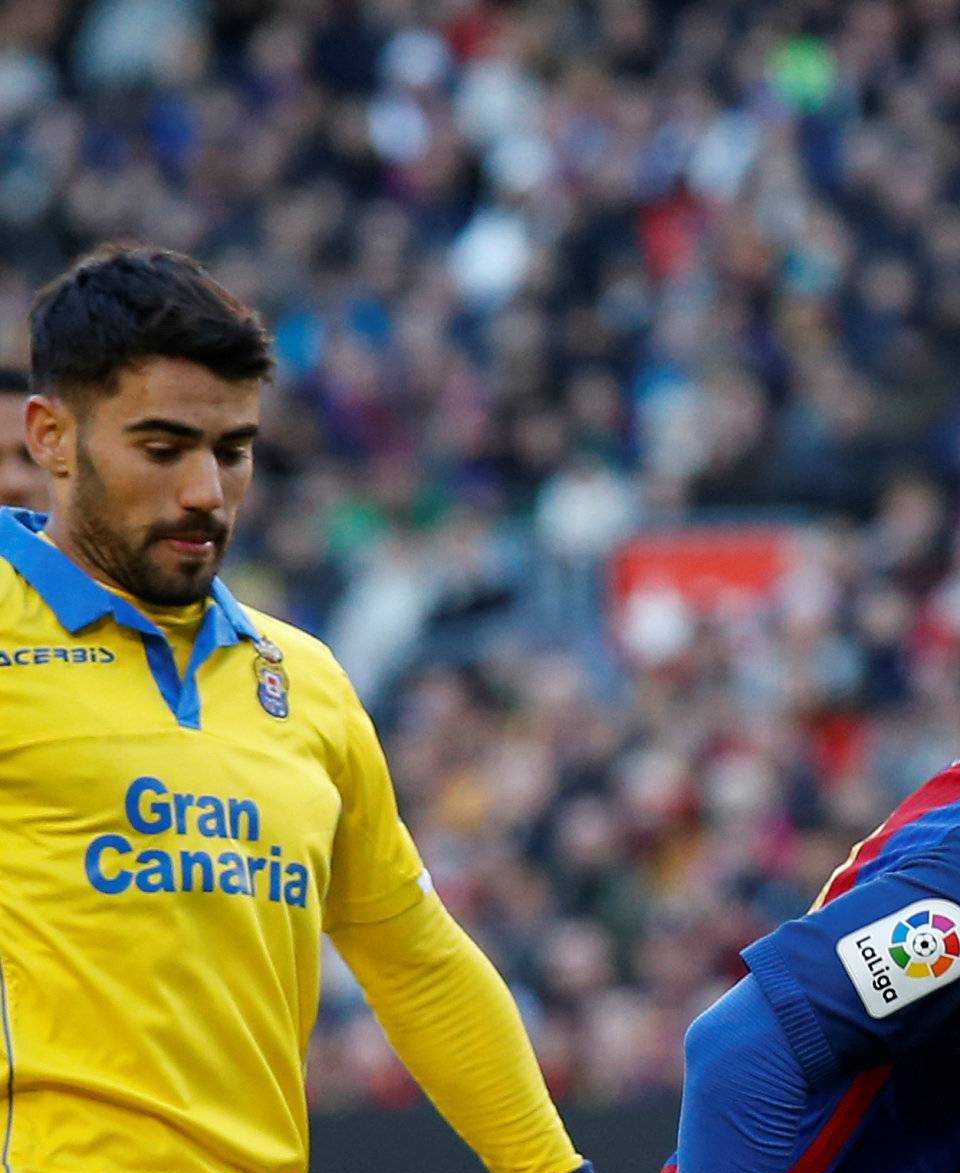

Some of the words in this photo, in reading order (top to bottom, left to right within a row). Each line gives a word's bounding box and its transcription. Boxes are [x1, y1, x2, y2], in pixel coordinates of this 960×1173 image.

[125, 776, 260, 842] Gran
[84, 833, 309, 908] Canaria
[855, 935, 899, 1004] LaLiga
